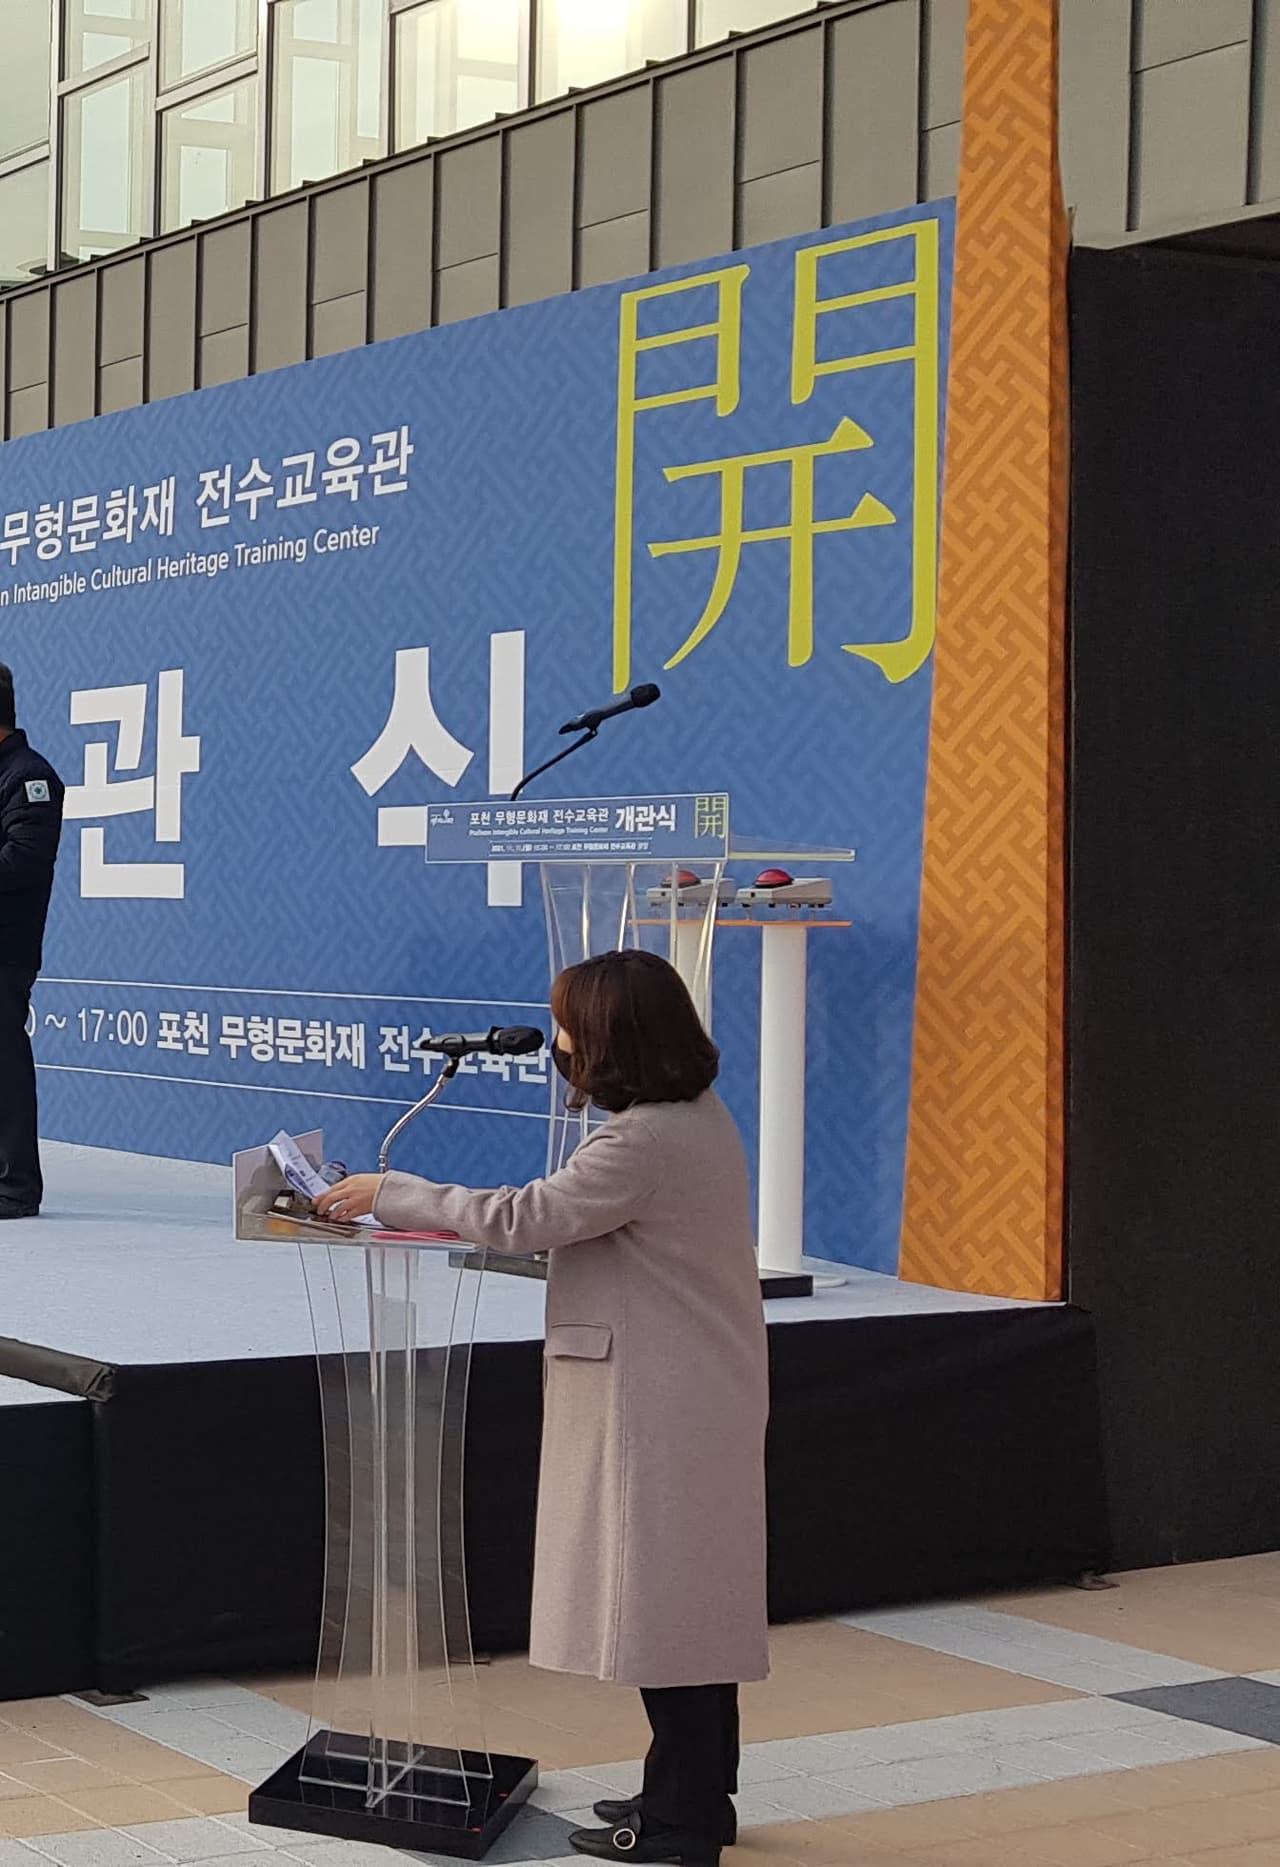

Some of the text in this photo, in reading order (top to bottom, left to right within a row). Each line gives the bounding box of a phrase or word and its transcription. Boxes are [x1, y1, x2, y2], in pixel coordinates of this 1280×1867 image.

[613, 218, 938, 694] 開
[0, 477, 176, 566] 무형문화재
[196, 425, 414, 529] 전수교육관
[13, 571, 86, 604] Intangible
[91, 559, 152, 591] Cultural
[157, 549, 229, 583] Heritage
[235, 534, 307, 570] Training
[313, 523, 379, 553] Center
[469, 811, 490, 826] 포천
[495, 809, 548, 825] 무형문화재
[553, 807, 609, 824] 전수교육관
[615, 804, 676, 832] 개관식
[694, 796, 727, 839] 開
[78, 1007, 148, 1046] 17:00
[157, 1010, 210, 1056] 포천
[219, 1014, 366, 1070] 무형문화재
